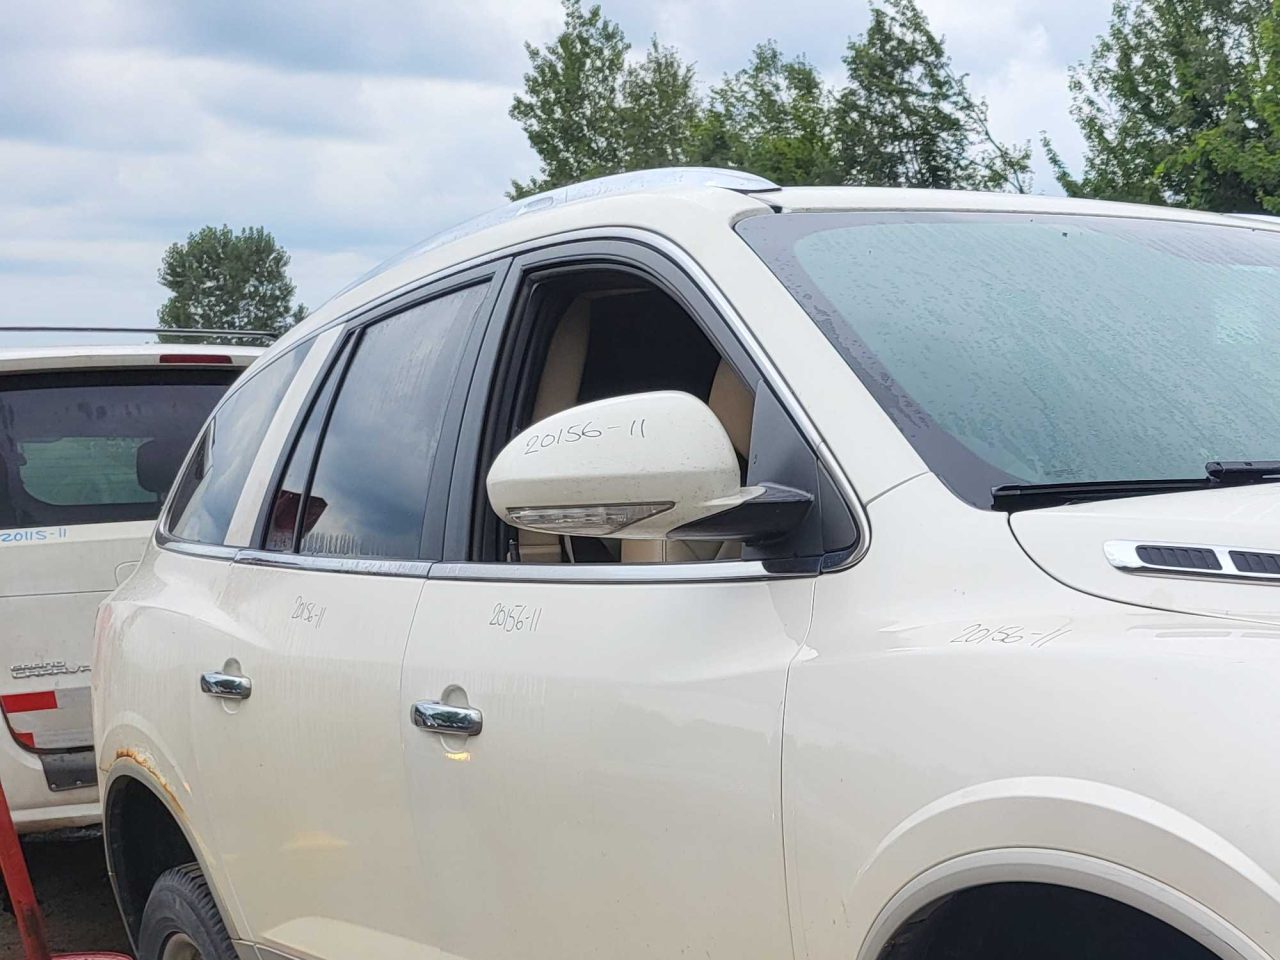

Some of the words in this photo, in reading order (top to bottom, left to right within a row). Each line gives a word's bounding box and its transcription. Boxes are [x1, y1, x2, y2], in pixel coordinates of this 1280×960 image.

[524, 418, 646, 455] 20156-11
[489, 602, 543, 632] 20156-11
[950, 623, 1073, 648] 20156-11
